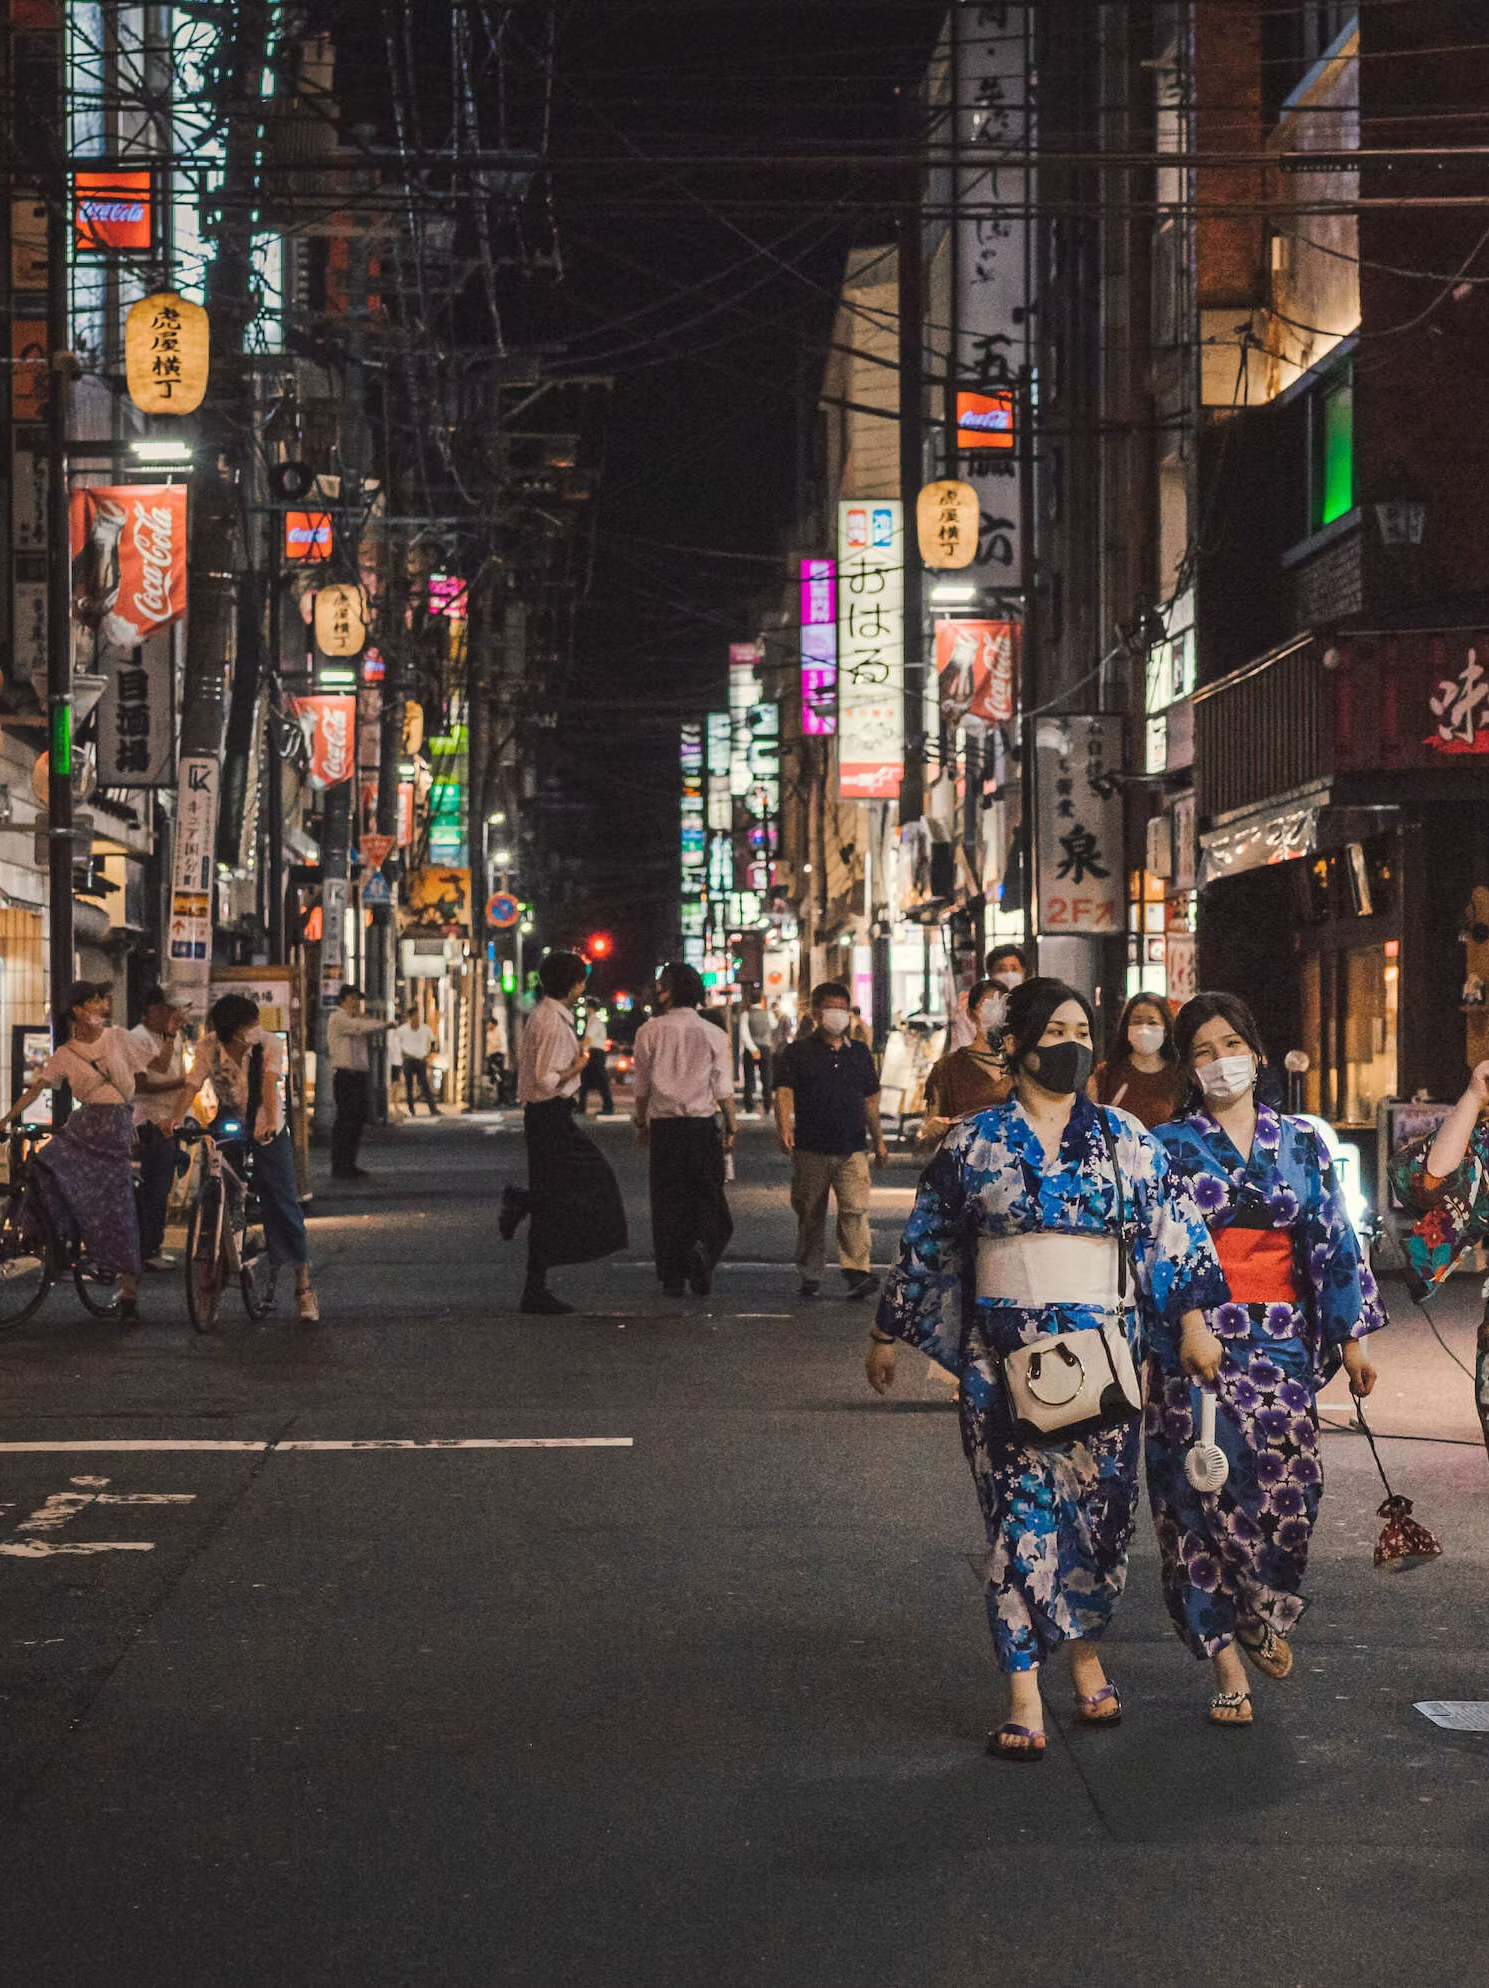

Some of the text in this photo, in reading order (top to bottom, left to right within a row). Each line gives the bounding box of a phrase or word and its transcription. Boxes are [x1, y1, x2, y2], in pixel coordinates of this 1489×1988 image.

[151, 306, 182, 399] 虎屋横丁
[133, 500, 172, 622] Coca-Cola
[939, 489, 960, 556] 虎屋横丁
[850, 556, 890, 684] おはる
[1056, 823, 1111, 885] 泉
